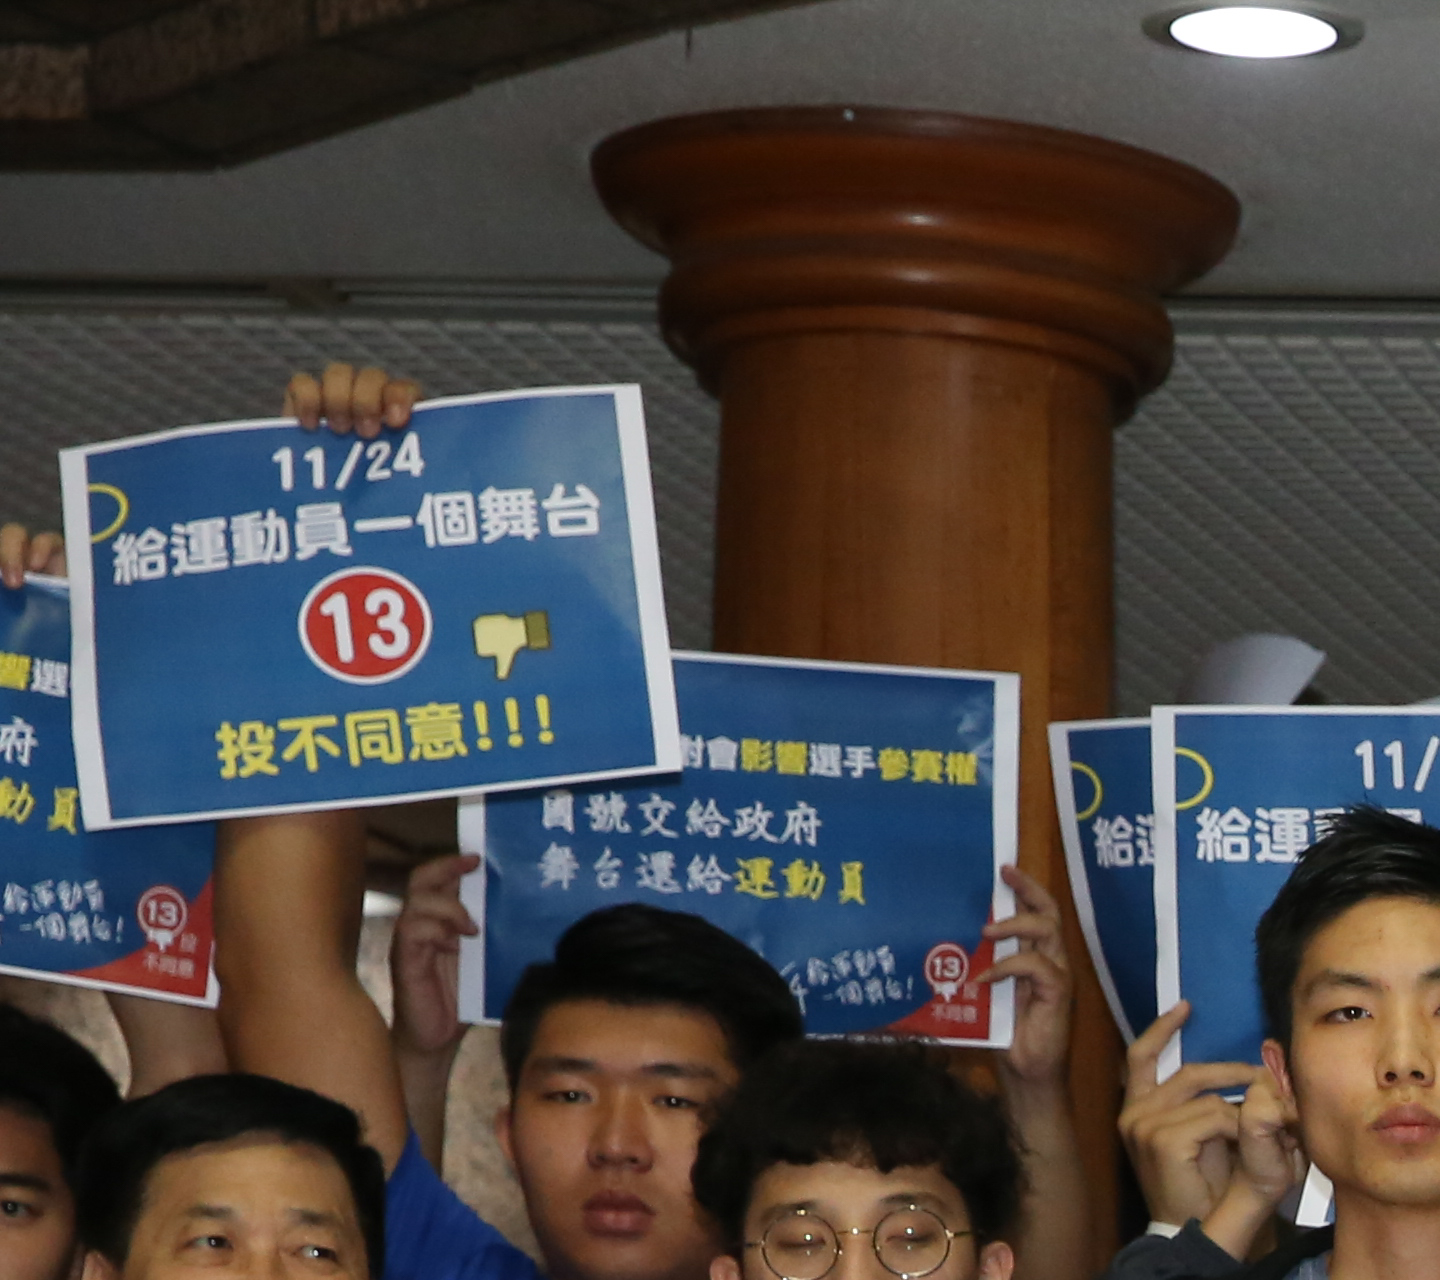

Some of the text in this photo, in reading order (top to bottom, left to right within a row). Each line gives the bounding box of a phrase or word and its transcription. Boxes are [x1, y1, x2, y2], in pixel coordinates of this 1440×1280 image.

[272, 432, 425, 492] 11/24
[113, 482, 600, 584] 給運動員一個舞台
[318, 586, 409, 666] 13
[215, 694, 558, 780] 投不同意!!!
[541, 789, 822, 848] 國號交給政府
[147, 901, 179, 925] 13
[932, 955, 961, 978] 13
